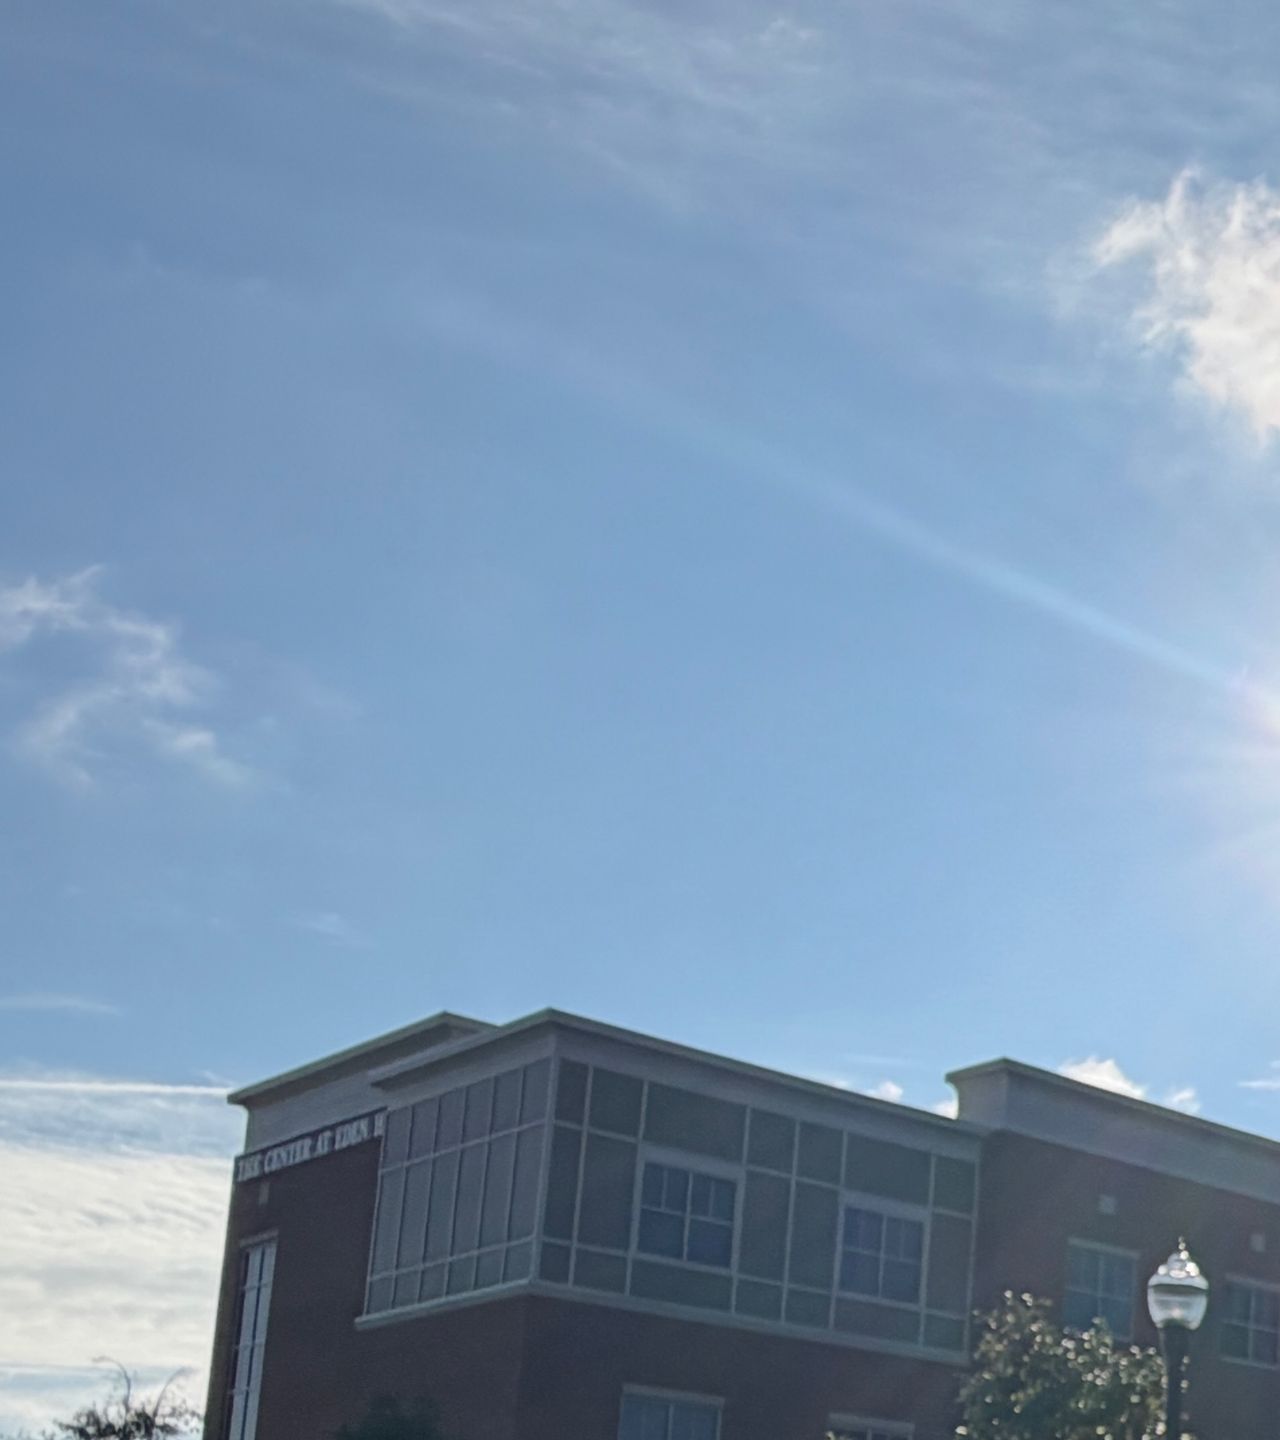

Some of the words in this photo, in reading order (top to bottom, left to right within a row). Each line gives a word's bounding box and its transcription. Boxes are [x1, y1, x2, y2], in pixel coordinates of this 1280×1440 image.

[238, 1154, 260, 1182] THE
[264, 1137, 312, 1173] CENTER
[315, 1129, 333, 1155] AT
[335, 1117, 370, 1149] EDEN
